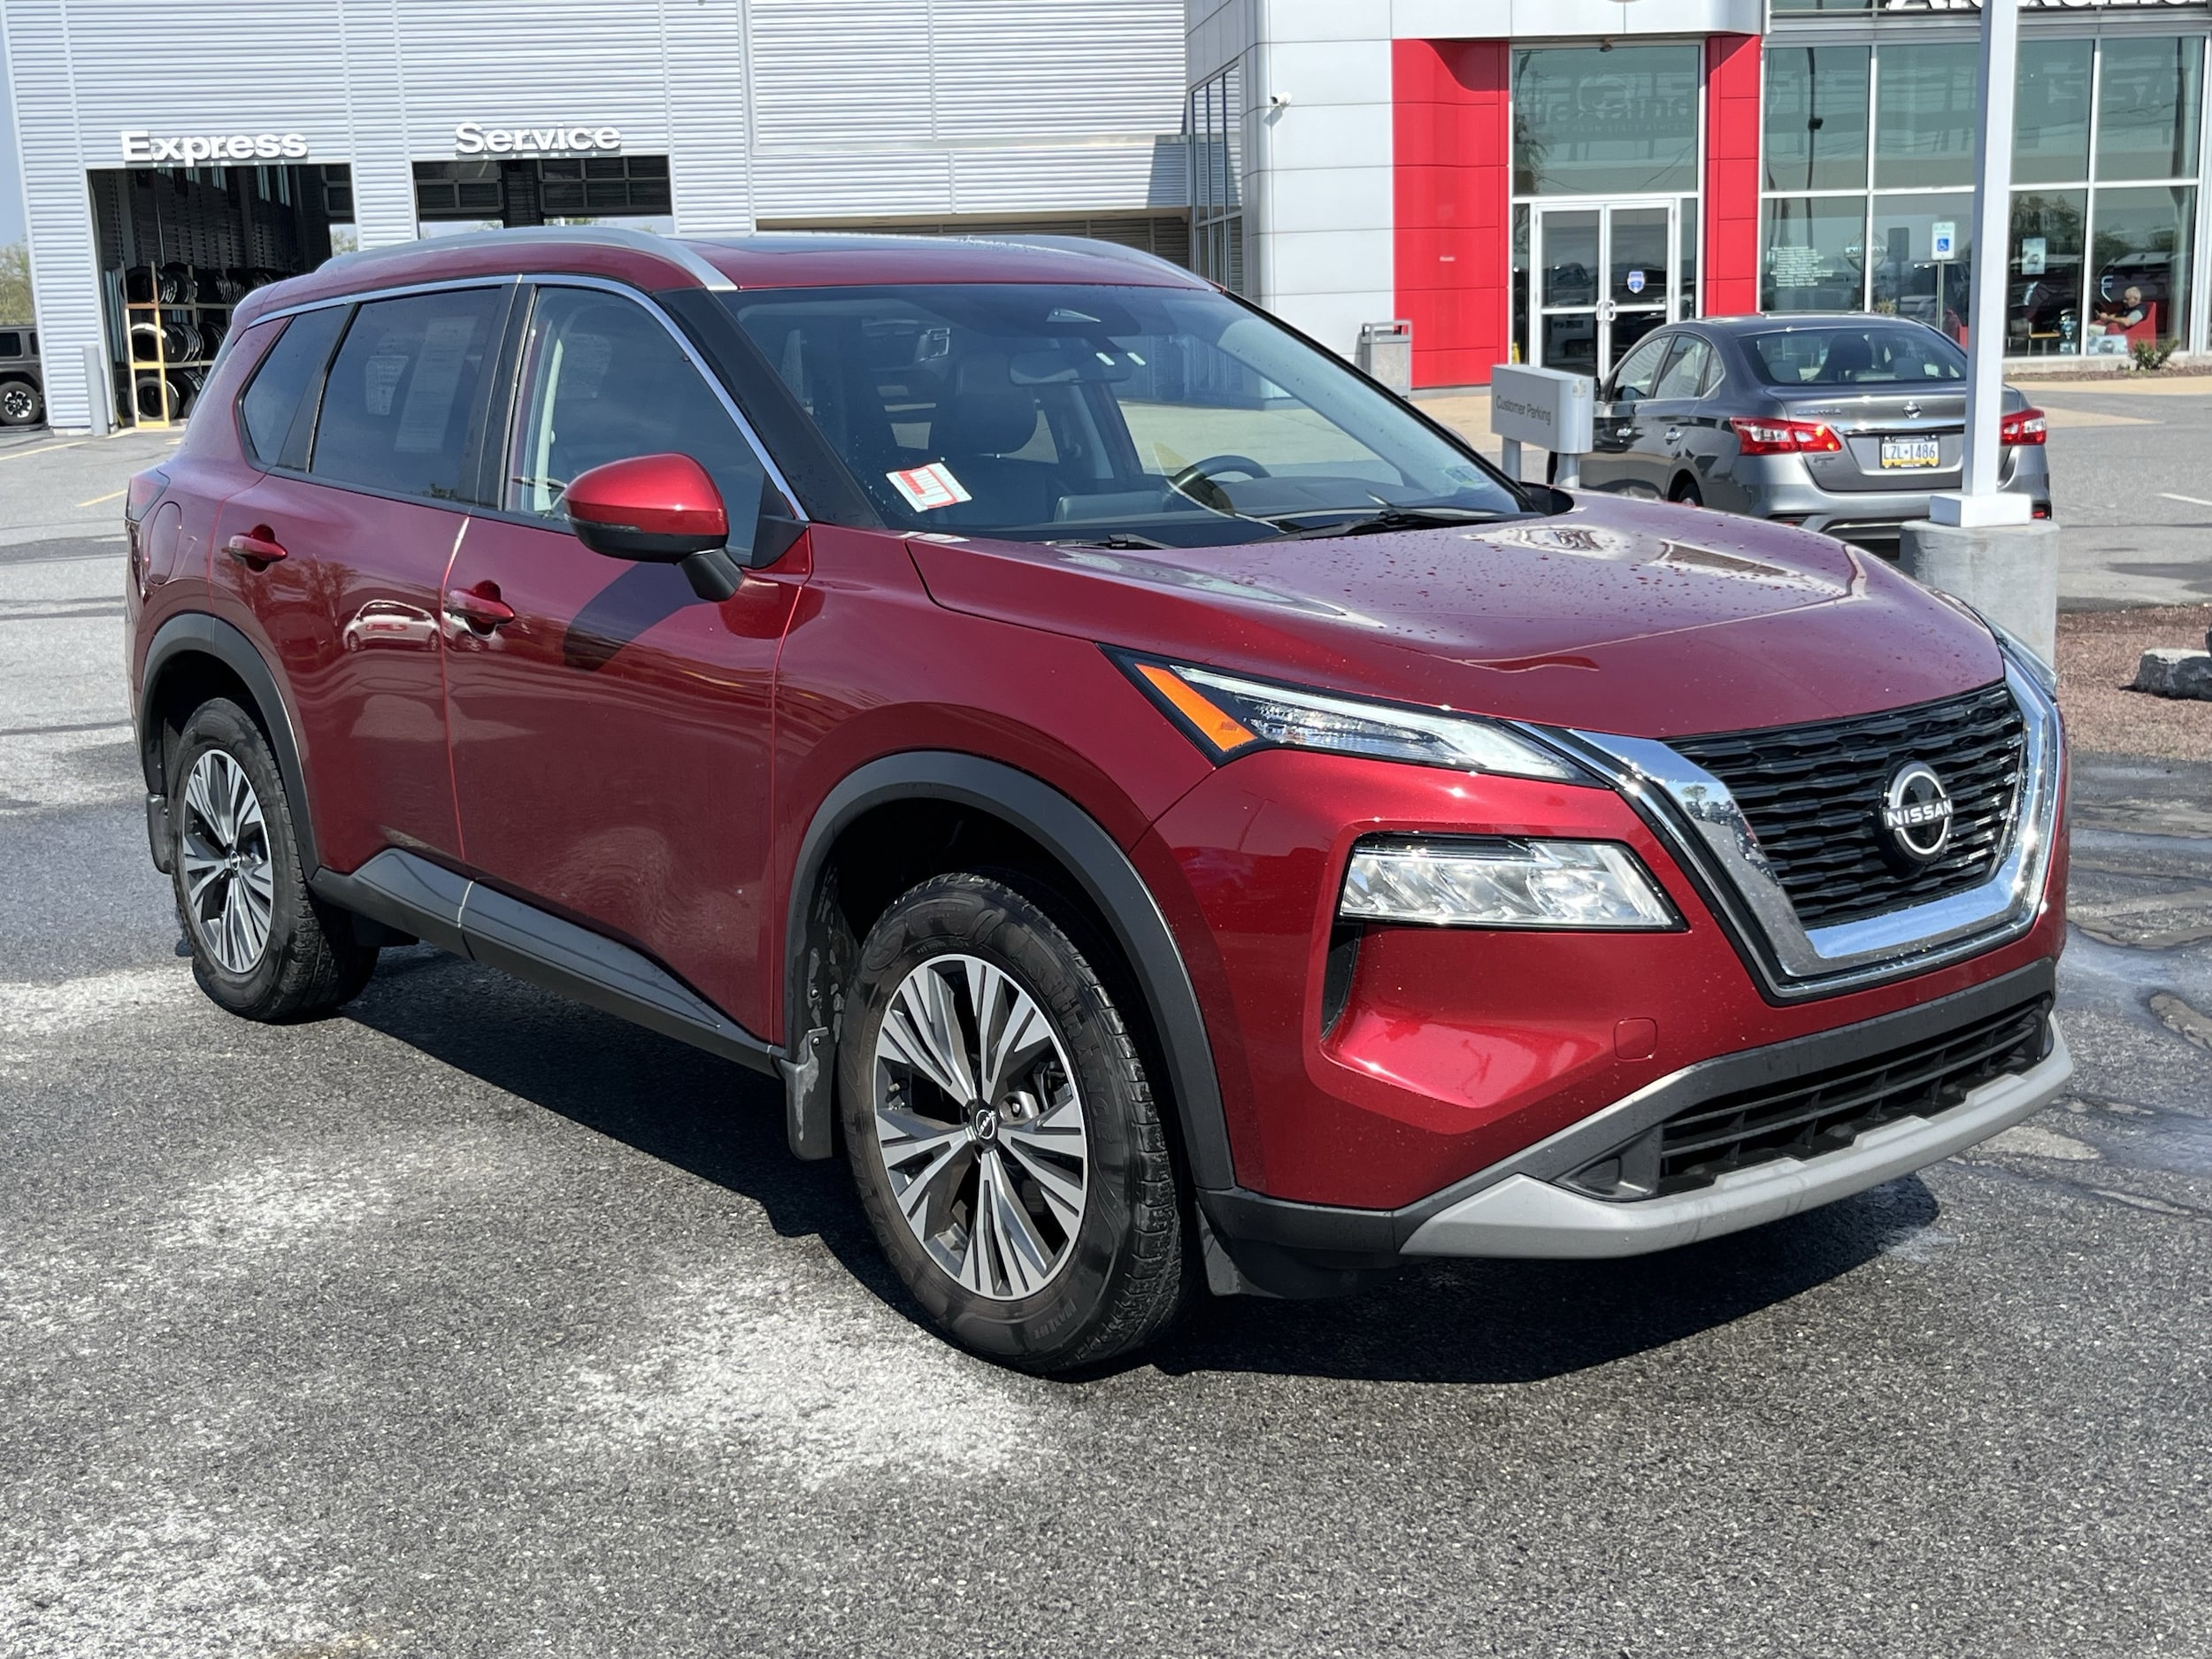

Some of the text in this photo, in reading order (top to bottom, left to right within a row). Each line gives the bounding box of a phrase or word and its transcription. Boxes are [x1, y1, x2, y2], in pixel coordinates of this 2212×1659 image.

[120, 130, 308, 166] Express
[456, 121, 621, 153] Service
[1496, 395, 1552, 426] Customer Parking
[1886, 798, 1953, 827] NISSAN
